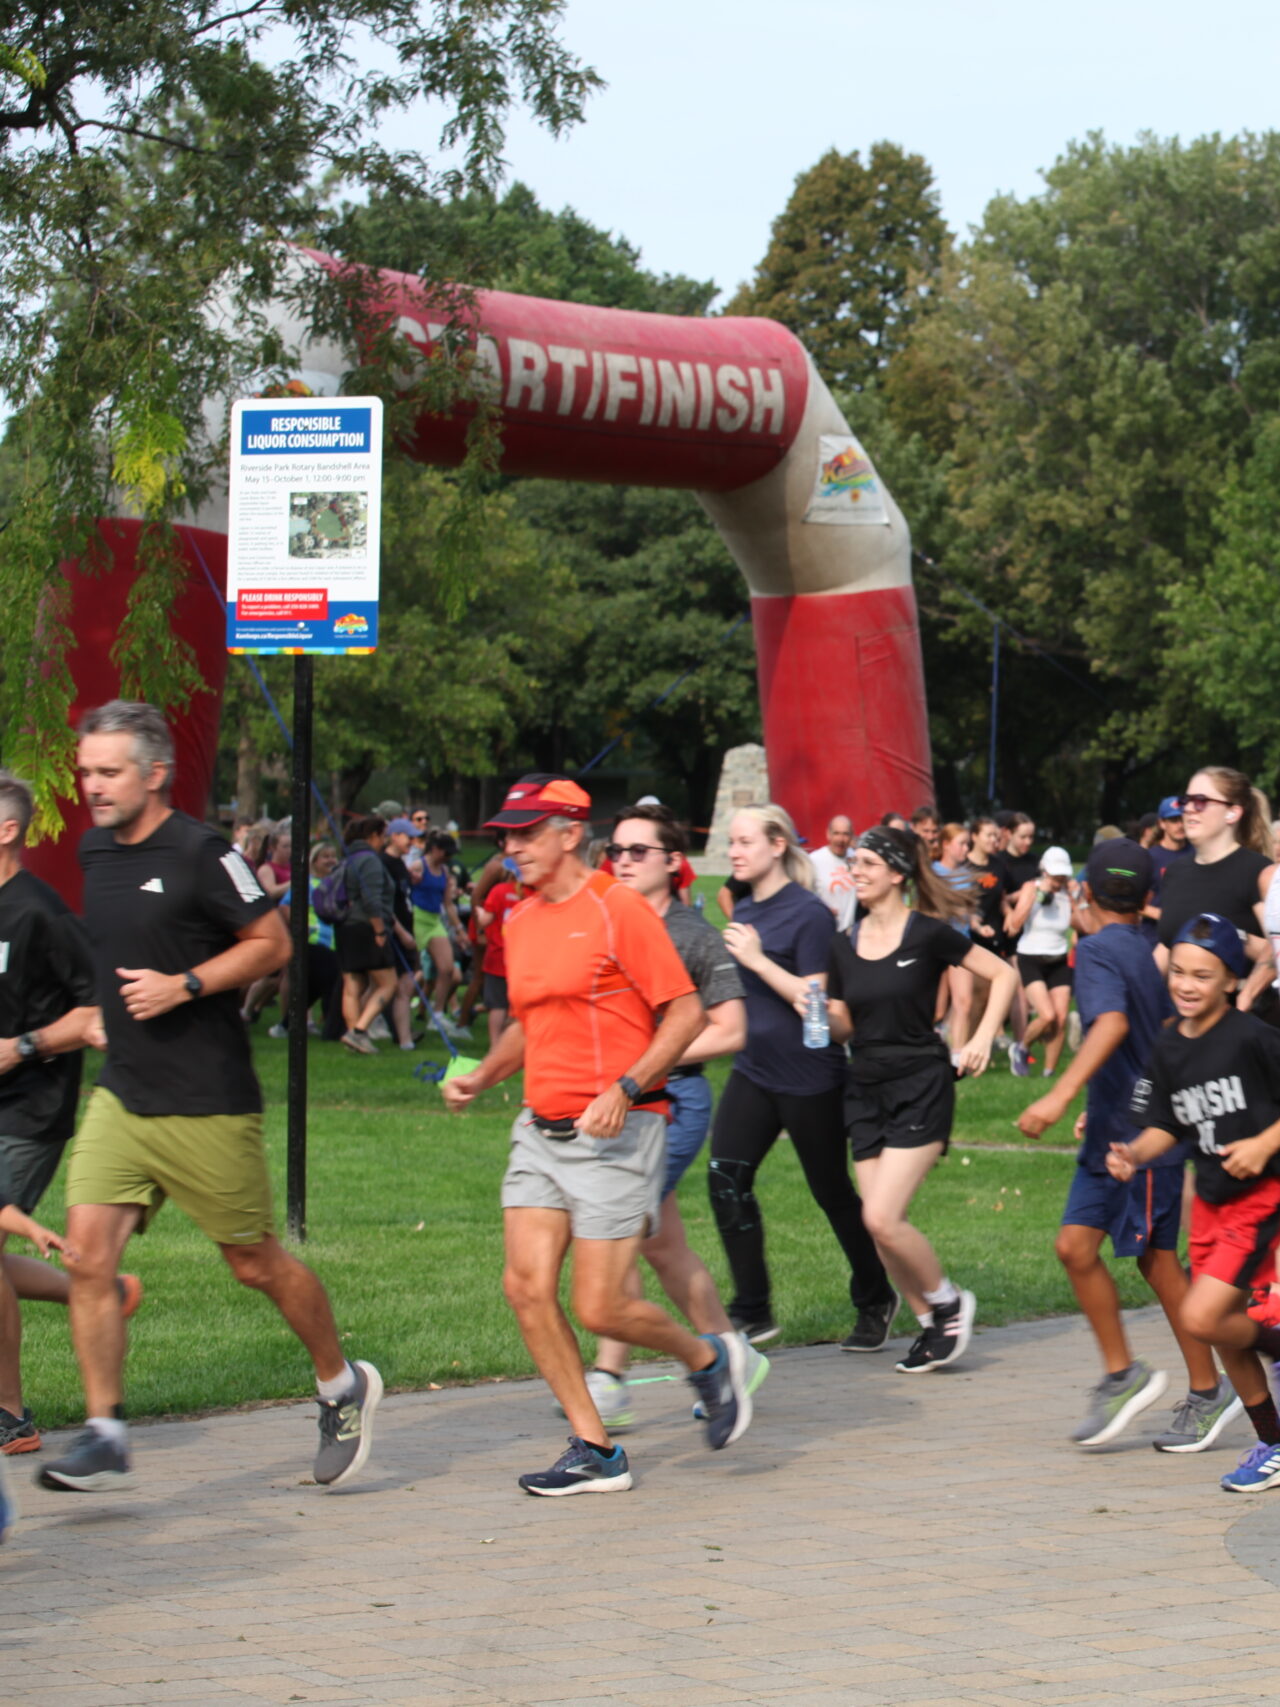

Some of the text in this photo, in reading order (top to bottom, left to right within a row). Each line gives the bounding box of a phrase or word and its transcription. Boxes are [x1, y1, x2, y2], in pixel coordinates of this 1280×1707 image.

[391, 314, 785, 436] SART/FINISH
[271, 416, 341, 431] RESPONSIBLE
[248, 432, 364, 449] LIQUOR CONSUMPTION
[240, 462, 370, 474] Riverside Park Rotary Bandshell Area
[245, 475, 260, 484] May
[274, 475, 303, 483] October
[313, 474, 332, 482] 12:00
[353, 475, 365, 484] pm
